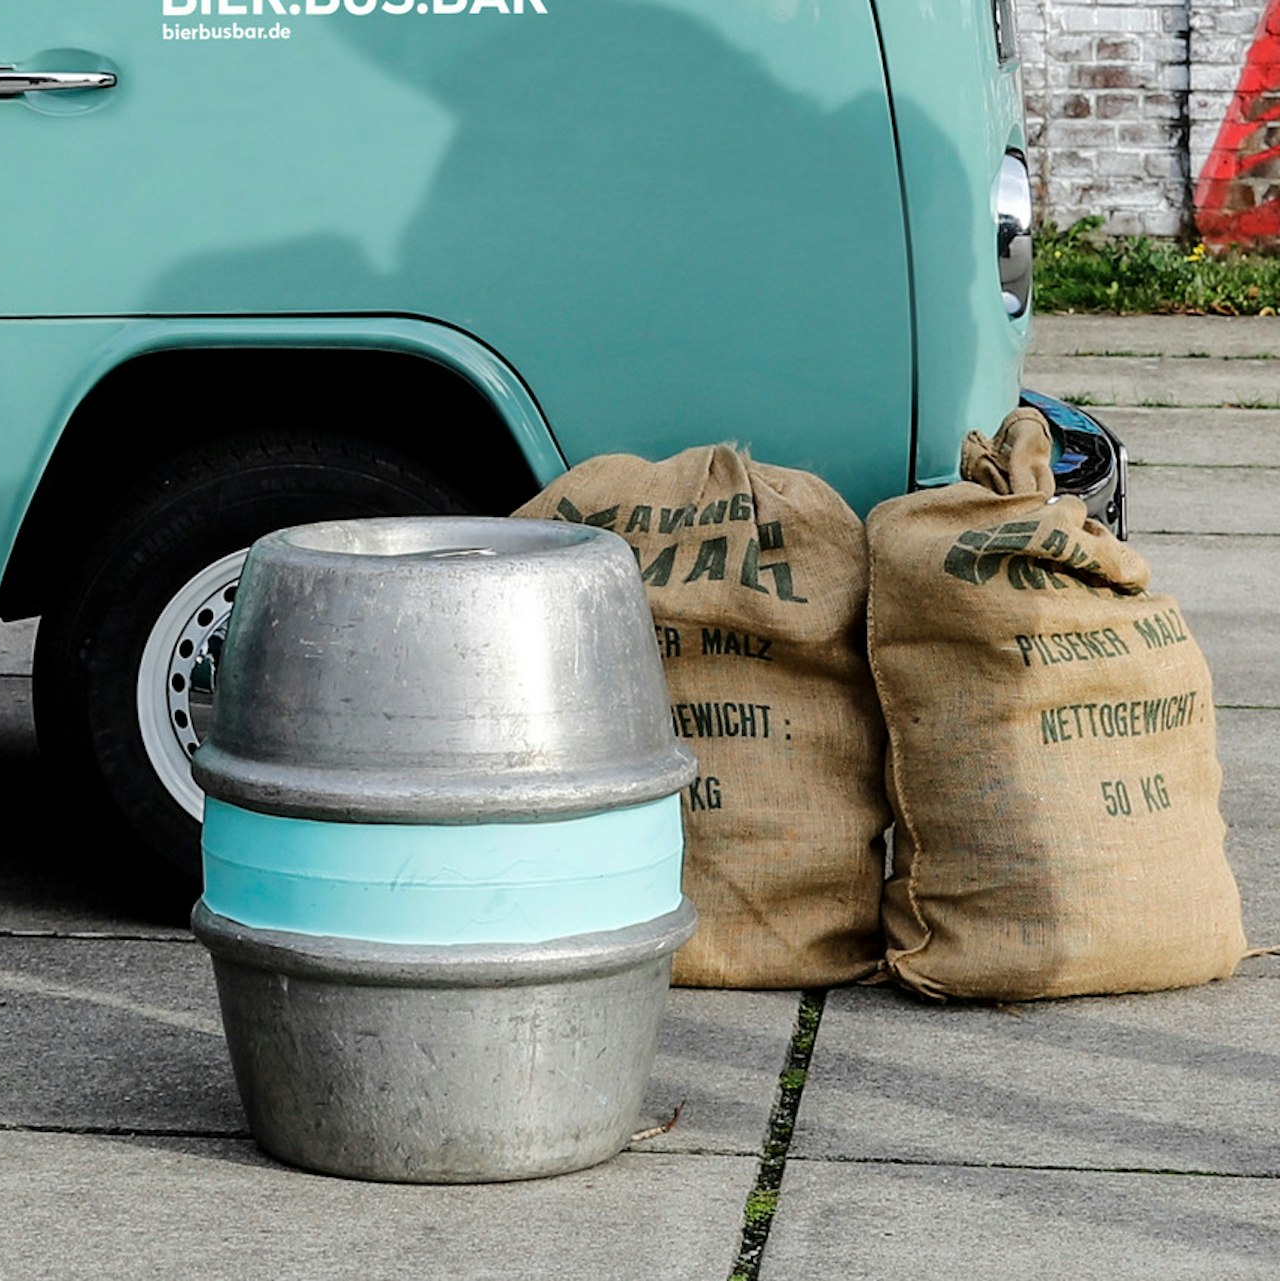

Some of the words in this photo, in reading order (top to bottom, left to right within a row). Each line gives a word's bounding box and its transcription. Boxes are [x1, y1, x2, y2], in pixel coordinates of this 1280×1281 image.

[162, 22, 291, 40] bierbusbar.de
[702, 627, 774, 661] MALZ
[1015, 628, 1130, 667] PILSENER
[1133, 608, 1187, 649] MALZ
[689, 776, 722, 812] KG
[1101, 779, 1132, 816] 50
[1141, 773, 1171, 813] KG
